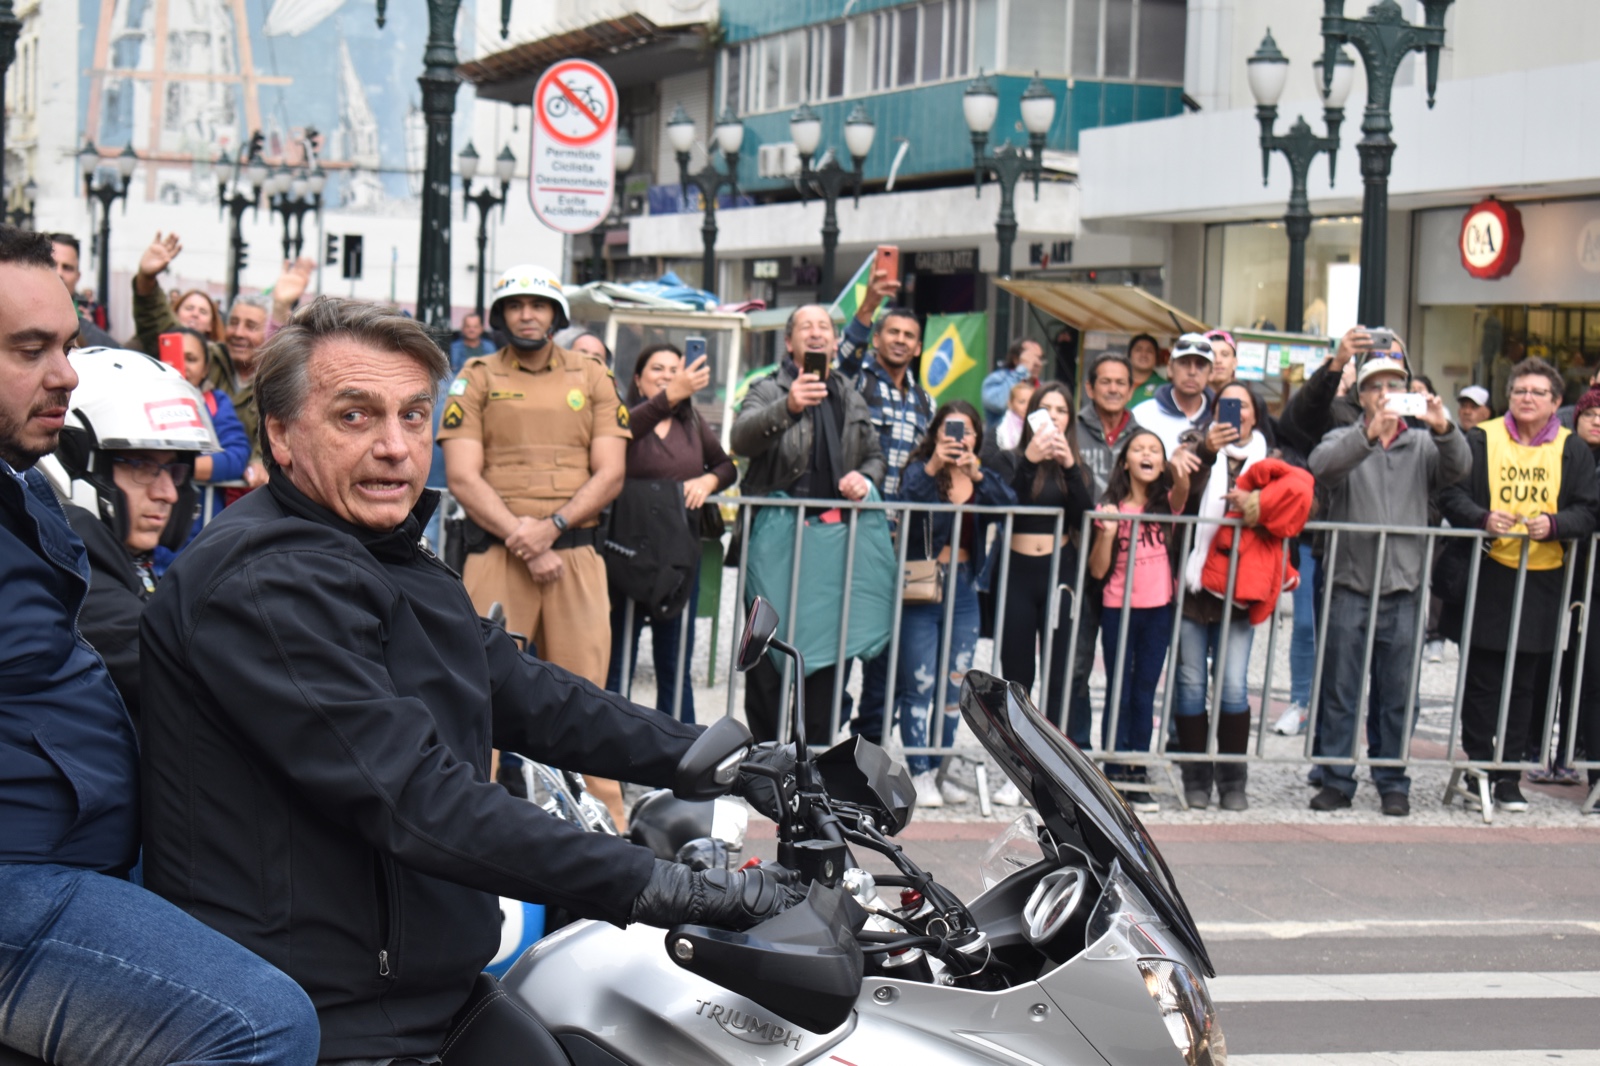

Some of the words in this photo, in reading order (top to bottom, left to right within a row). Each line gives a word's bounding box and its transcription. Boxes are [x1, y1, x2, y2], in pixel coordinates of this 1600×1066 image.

[546, 147, 601, 160] Permitido
[552, 160, 594, 173] Ciclista
[535, 173, 608, 188] Desmontado
[558, 195, 586, 206] Evite
[696, 999, 804, 1051] TRIUMPH
